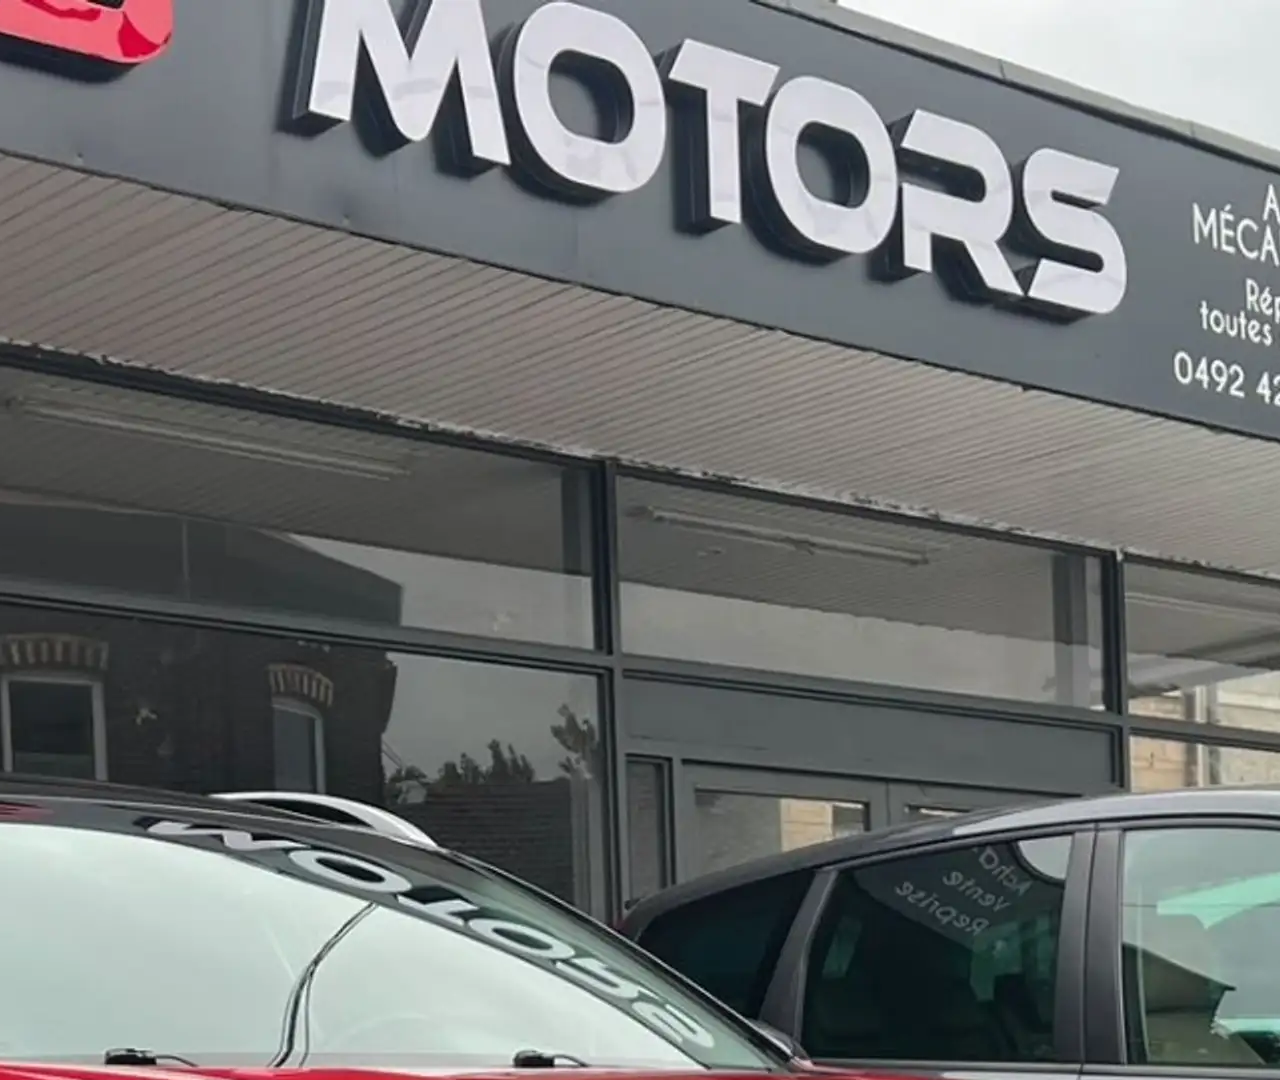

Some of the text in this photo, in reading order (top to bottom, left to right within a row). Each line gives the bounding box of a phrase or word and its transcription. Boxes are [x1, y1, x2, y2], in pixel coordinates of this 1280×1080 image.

[308, 0, 1126, 315] MOTORS
[1199, 300, 1272, 347] toutes
[1173, 350, 1245, 398] 0492
